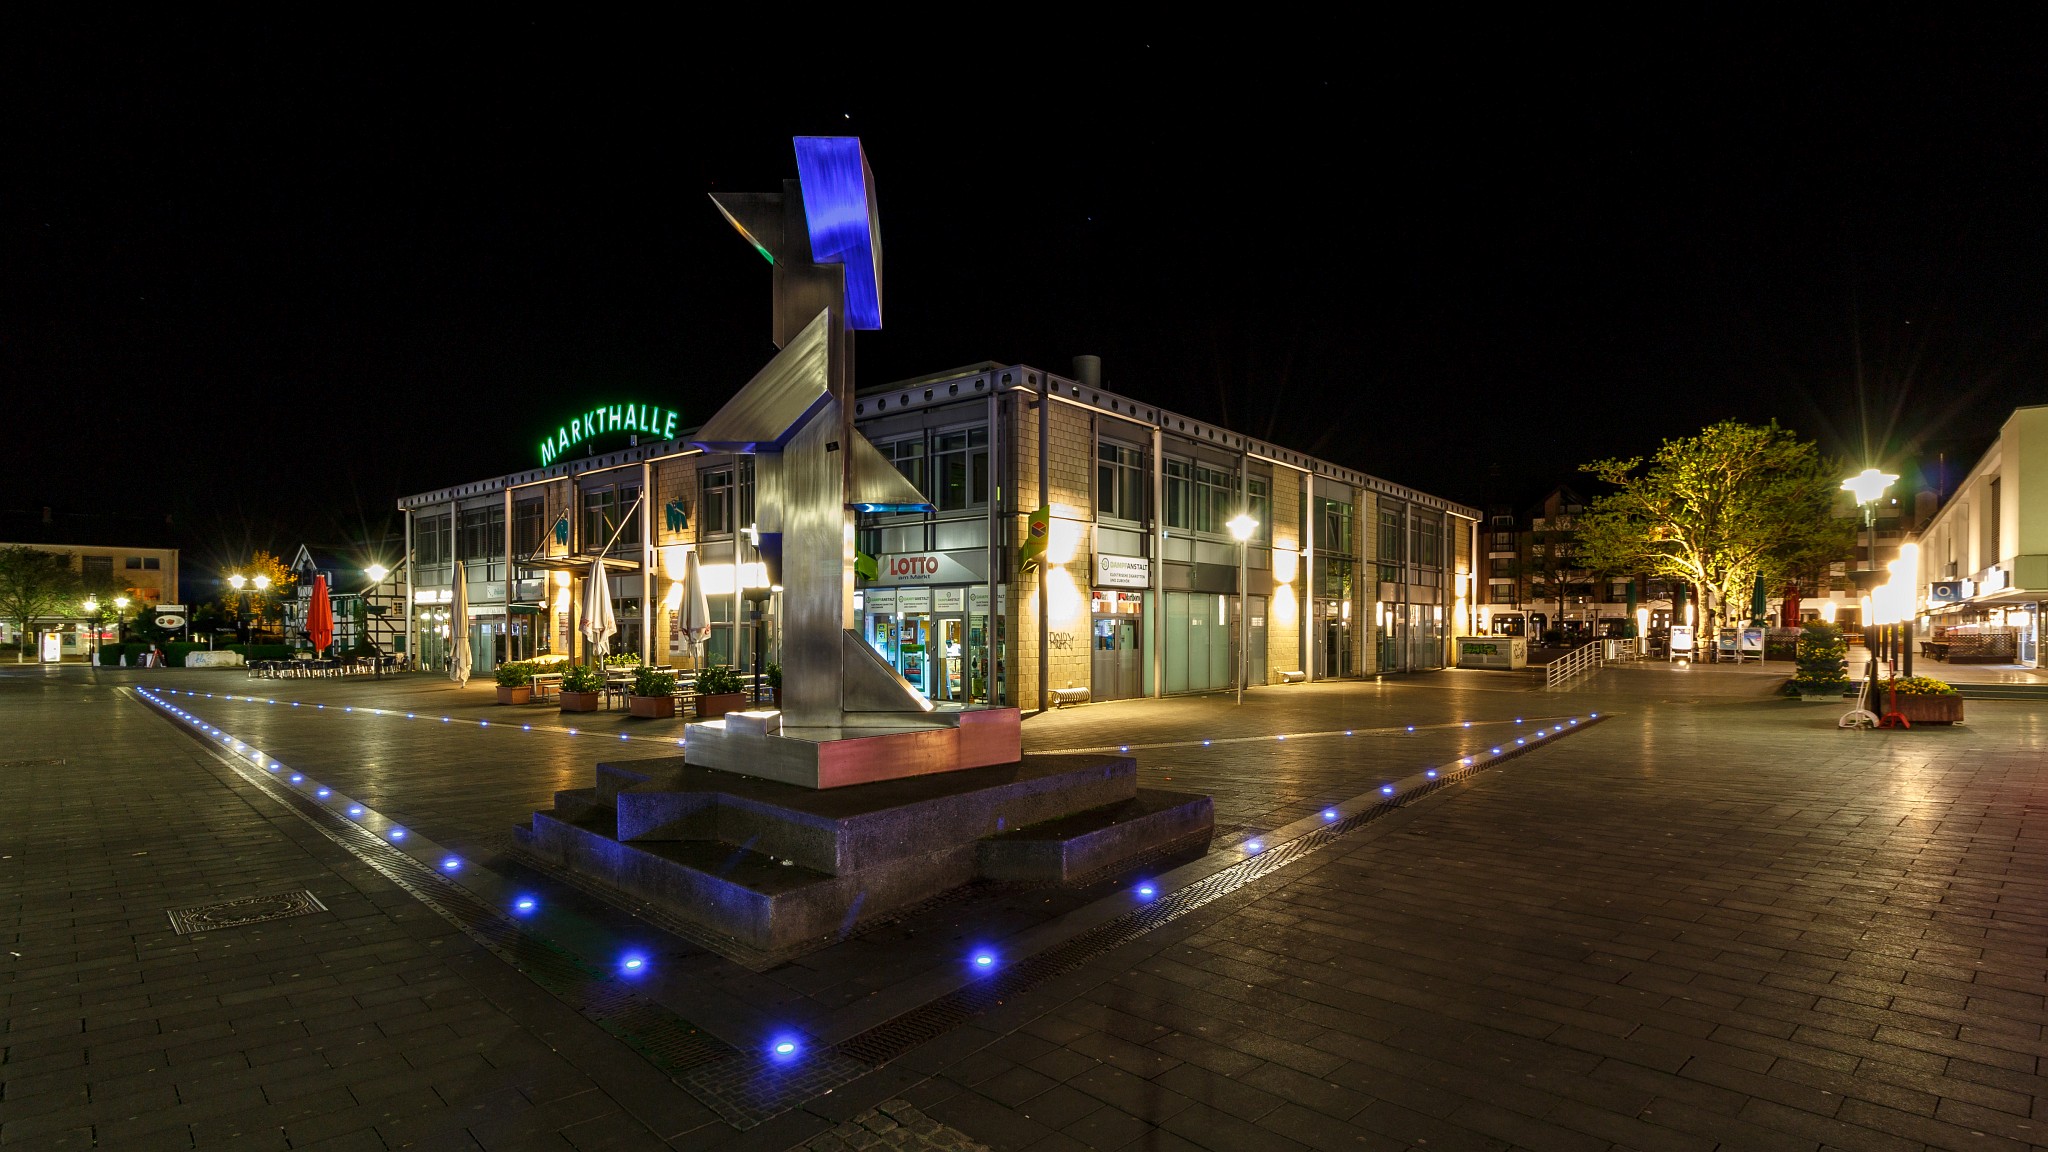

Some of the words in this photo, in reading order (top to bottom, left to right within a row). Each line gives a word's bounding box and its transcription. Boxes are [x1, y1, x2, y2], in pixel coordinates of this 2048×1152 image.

[540, 403, 678, 467] MARKTHALLE
[890, 556, 939, 576] LOTTO
[1110, 561, 1148, 571] DAMPFANSTALT
